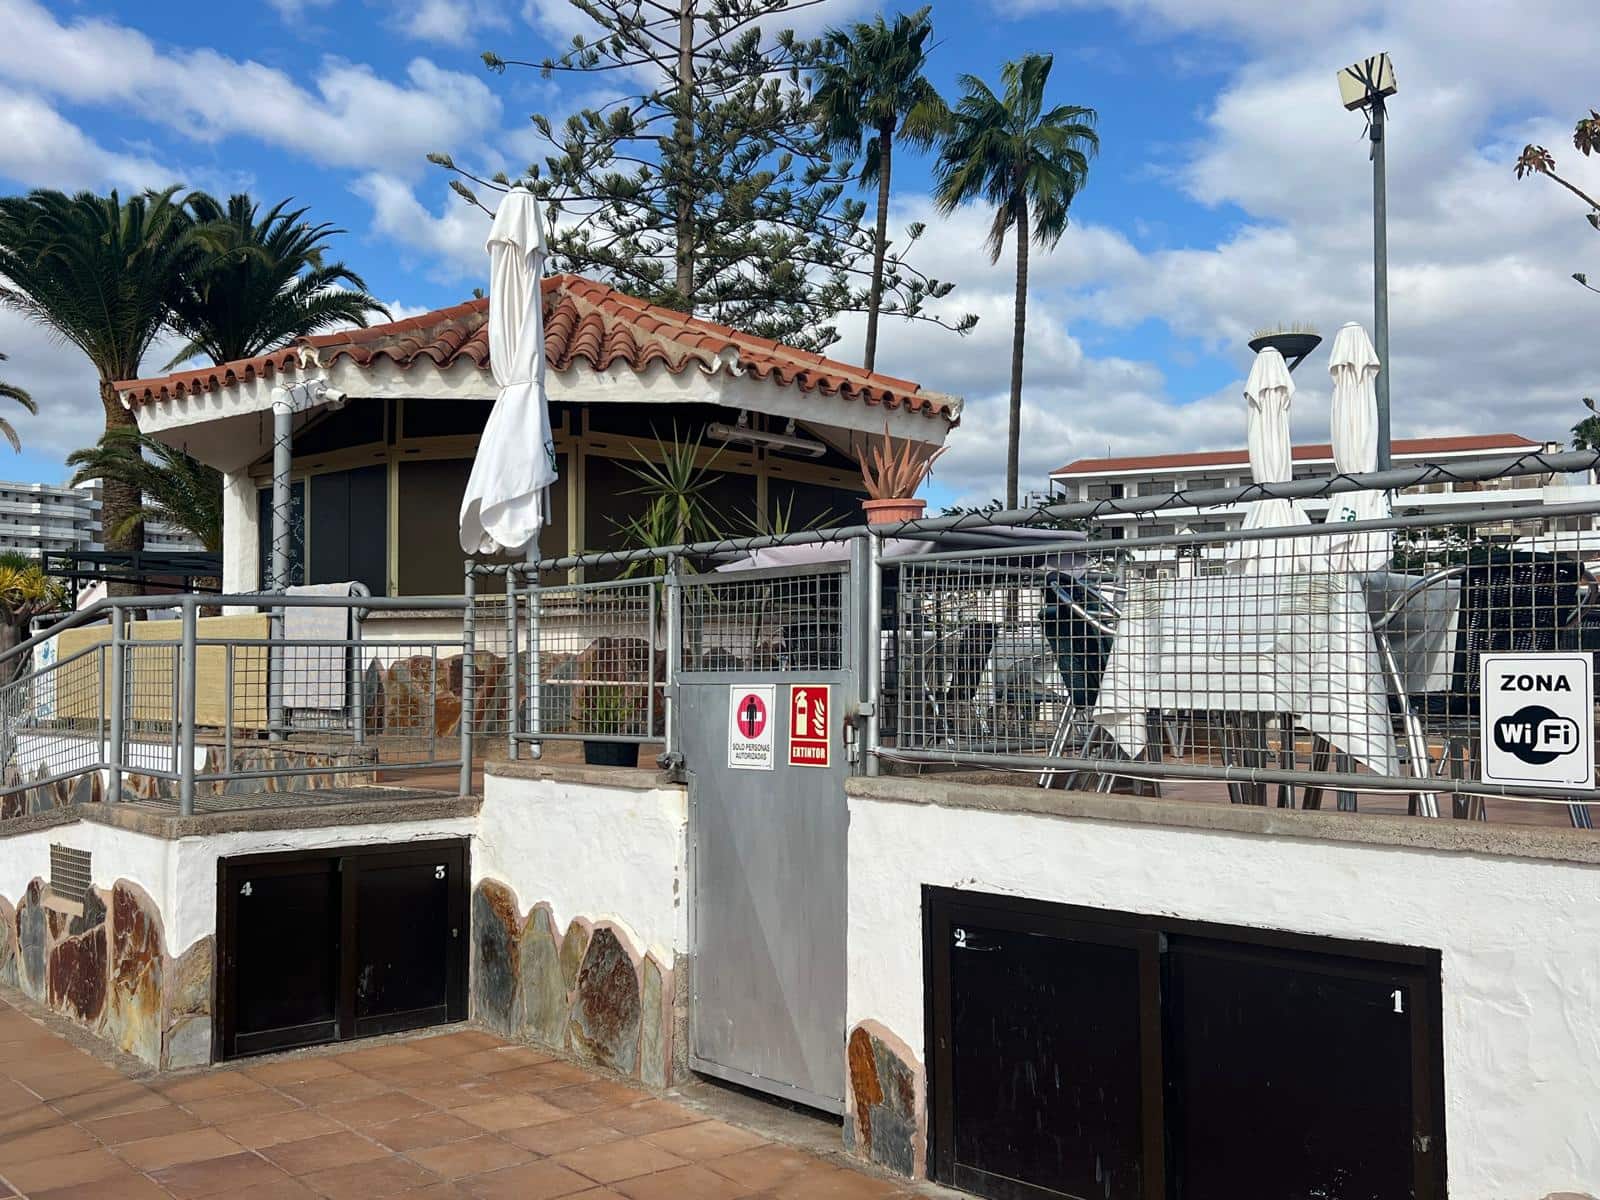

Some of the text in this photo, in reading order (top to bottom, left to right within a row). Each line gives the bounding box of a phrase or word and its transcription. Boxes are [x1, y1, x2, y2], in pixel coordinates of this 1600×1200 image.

[1500, 674, 1571, 692] ZONA
[745, 743, 770, 752] PERSONAS
[792, 746, 826, 758] EXTINTOR
[735, 752, 767, 760] AUTORIZADAS
[434, 865, 446, 879] 3
[240, 881, 253, 896] 4
[954, 928, 967, 948] 2
[1390, 990, 1404, 1013] 1
